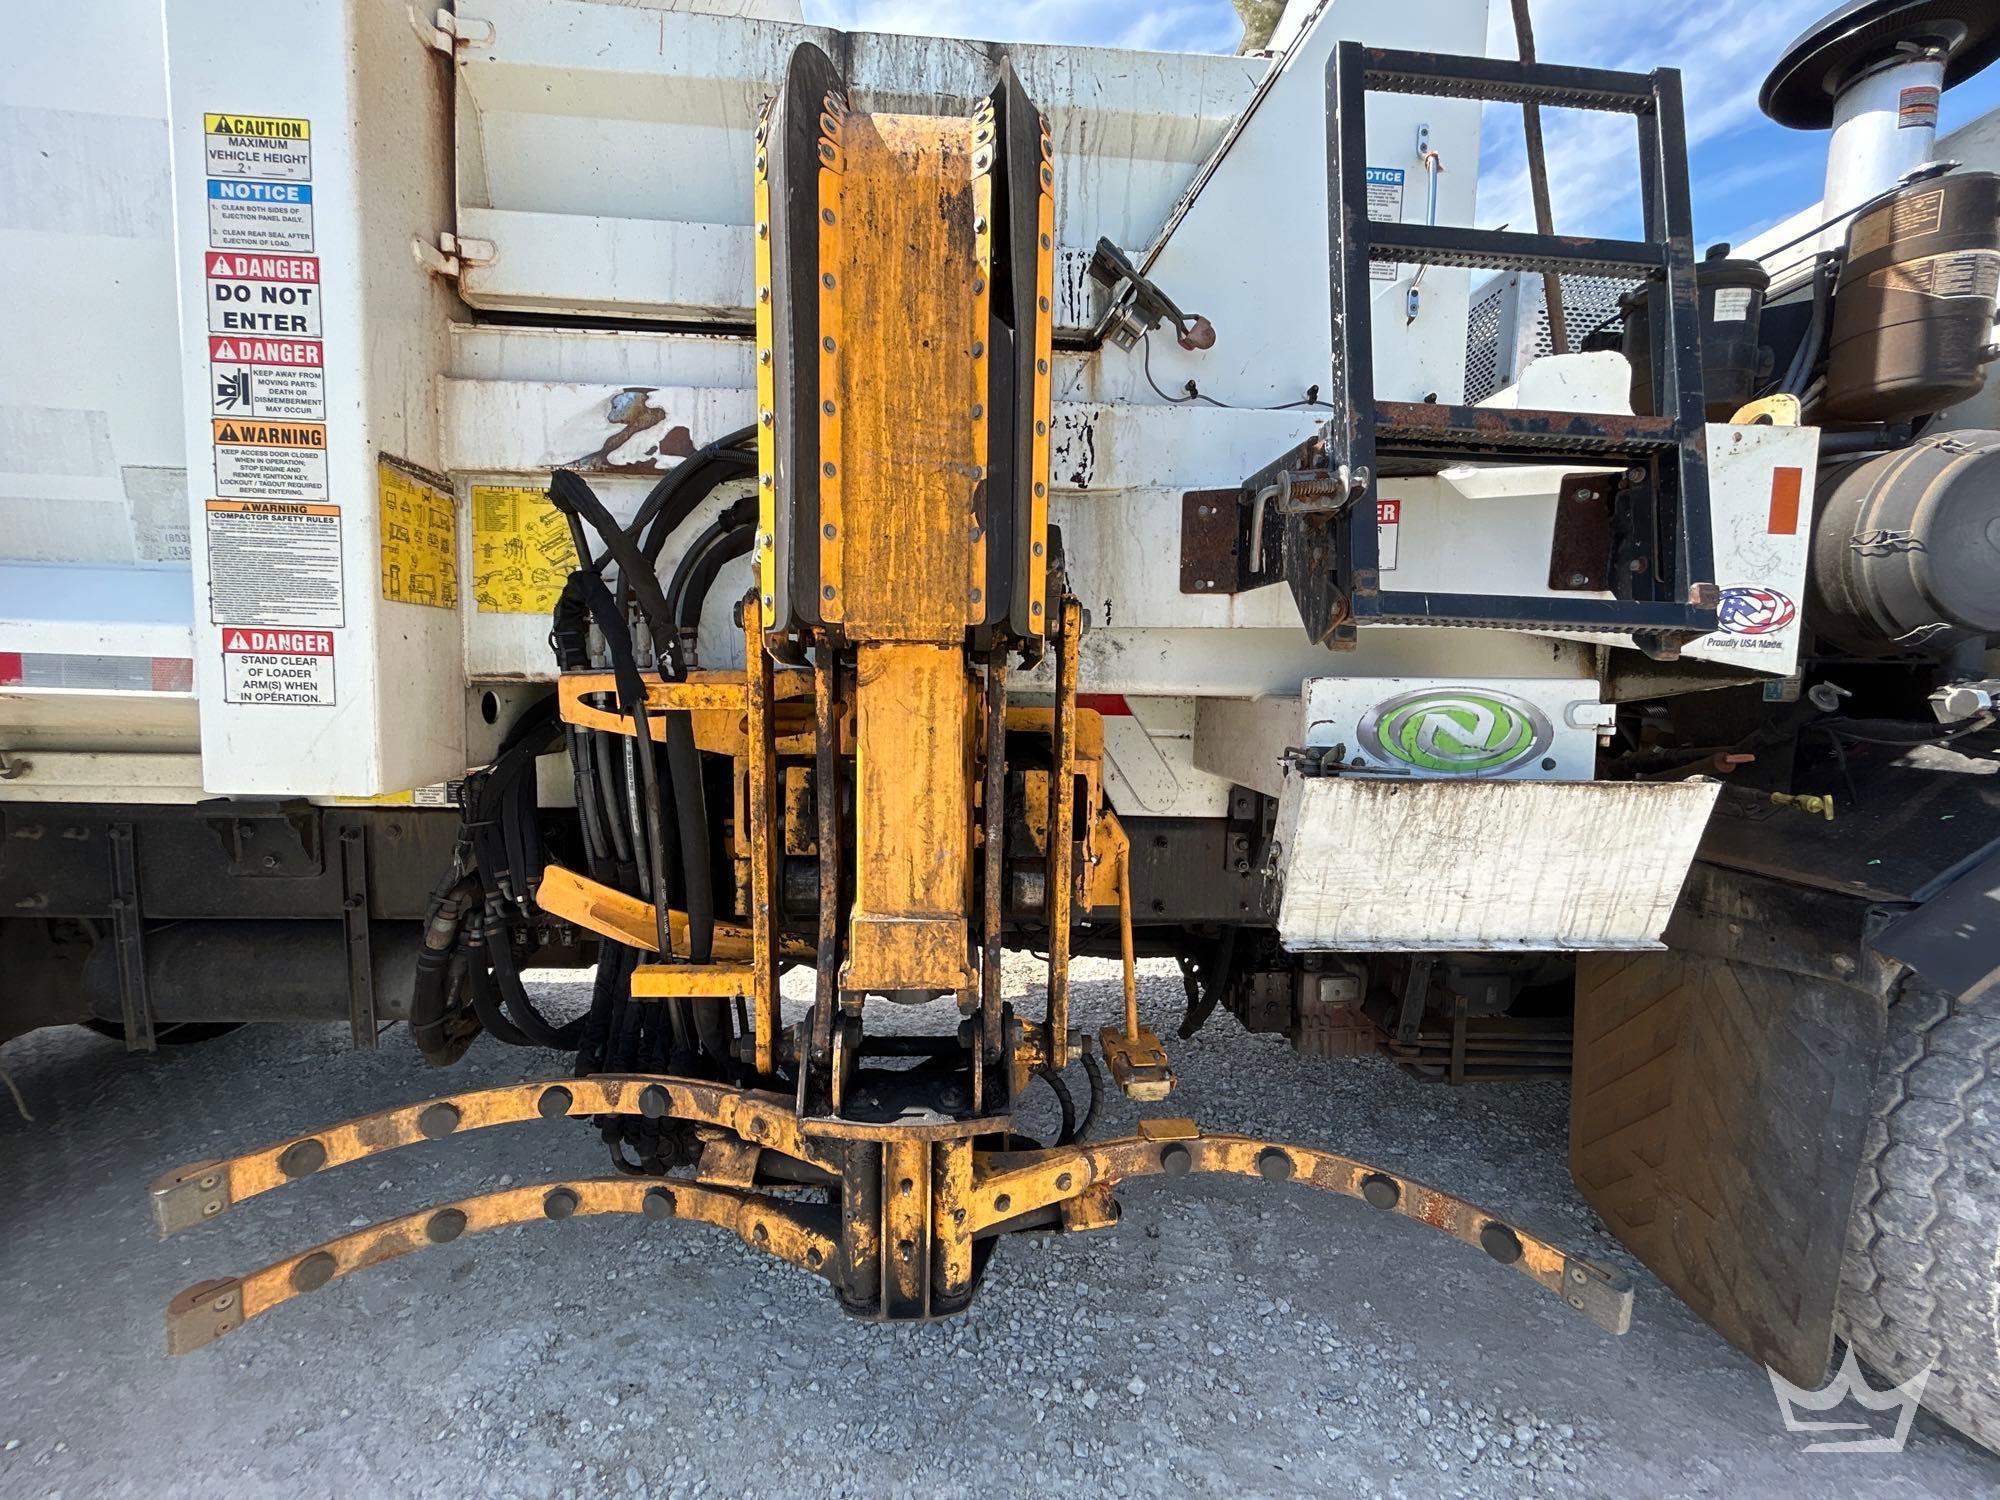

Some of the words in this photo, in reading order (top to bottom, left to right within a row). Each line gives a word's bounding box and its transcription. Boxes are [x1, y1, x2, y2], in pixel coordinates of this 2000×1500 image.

[234, 119, 302, 138] CAUTION
[228, 137, 288, 150] MAXIMUM
[210, 150, 260, 162] VEHICLE
[264, 153, 308, 164] HEIGHT
[1366, 170, 1402, 182] OTICE
[220, 183, 299, 201] NOTICE
[235, 258, 315, 280] DANGER
[216, 284, 251, 302] DO
[261, 286, 312, 306] NOT
[224, 312, 307, 332] ENTER
[240, 342, 319, 364] DANGER
[255, 397, 322, 406] DISMEMBERMENT
[240, 427, 322, 446] WARNING
[252, 504, 308, 514] WARNING
[214, 512, 268, 520] COMPACTOR
[251, 633, 329, 652] DANGER
[1707, 638, 1739, 649] Proudly
[1740, 639, 1757, 648] USA
[241, 656, 277, 665] STAND
[281, 656, 317, 666] CLEAR
[248, 668, 263, 677] OF
[266, 669, 311, 678] LOADER
[243, 681, 282, 691] ARM(S)
[284, 682, 318, 690] WHEN
[240, 693, 252, 701] IN
[255, 693, 321, 703] OPERATION.
